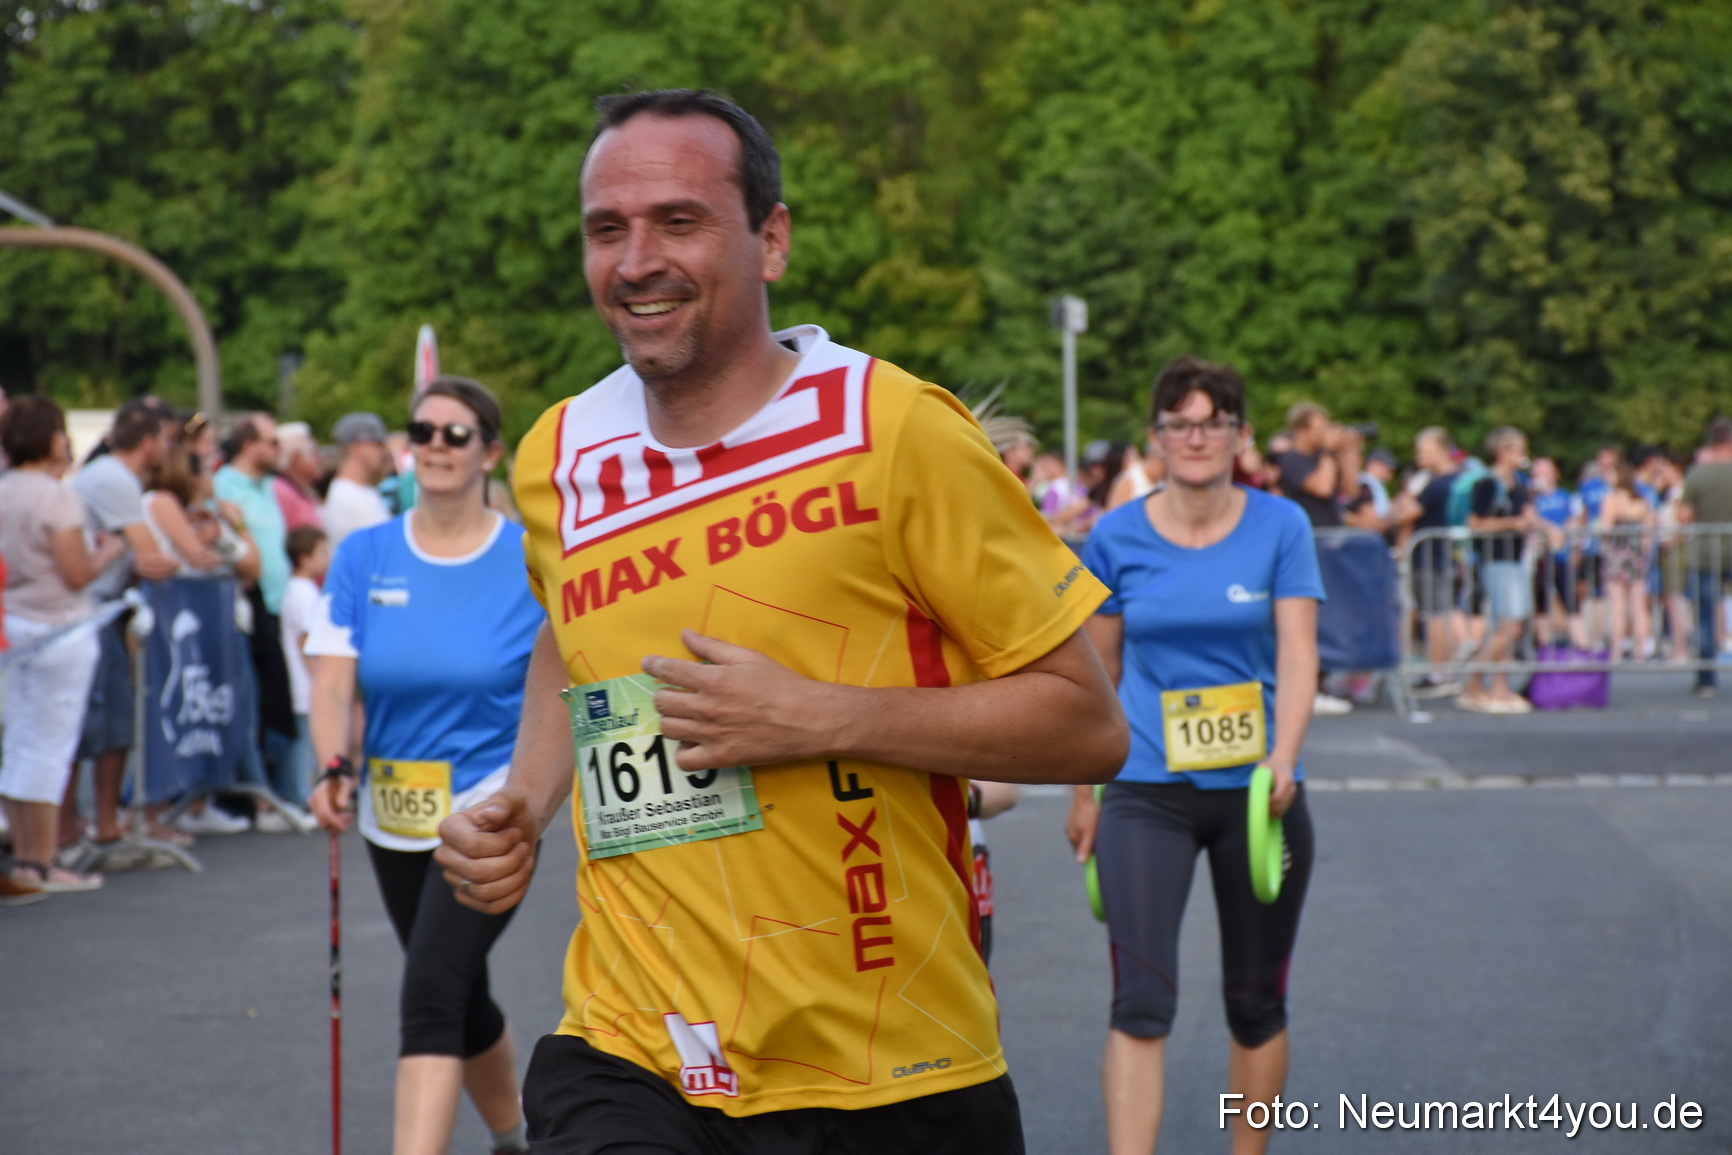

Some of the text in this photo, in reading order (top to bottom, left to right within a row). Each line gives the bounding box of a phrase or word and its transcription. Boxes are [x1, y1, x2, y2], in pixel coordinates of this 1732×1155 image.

[562, 480, 879, 625] MAX BÖGL
[1179, 712, 1254, 747] 1085
[378, 787, 437, 817] 1065
[645, 793, 722, 817] Sebastian
[690, 808, 726, 823] GmbH
